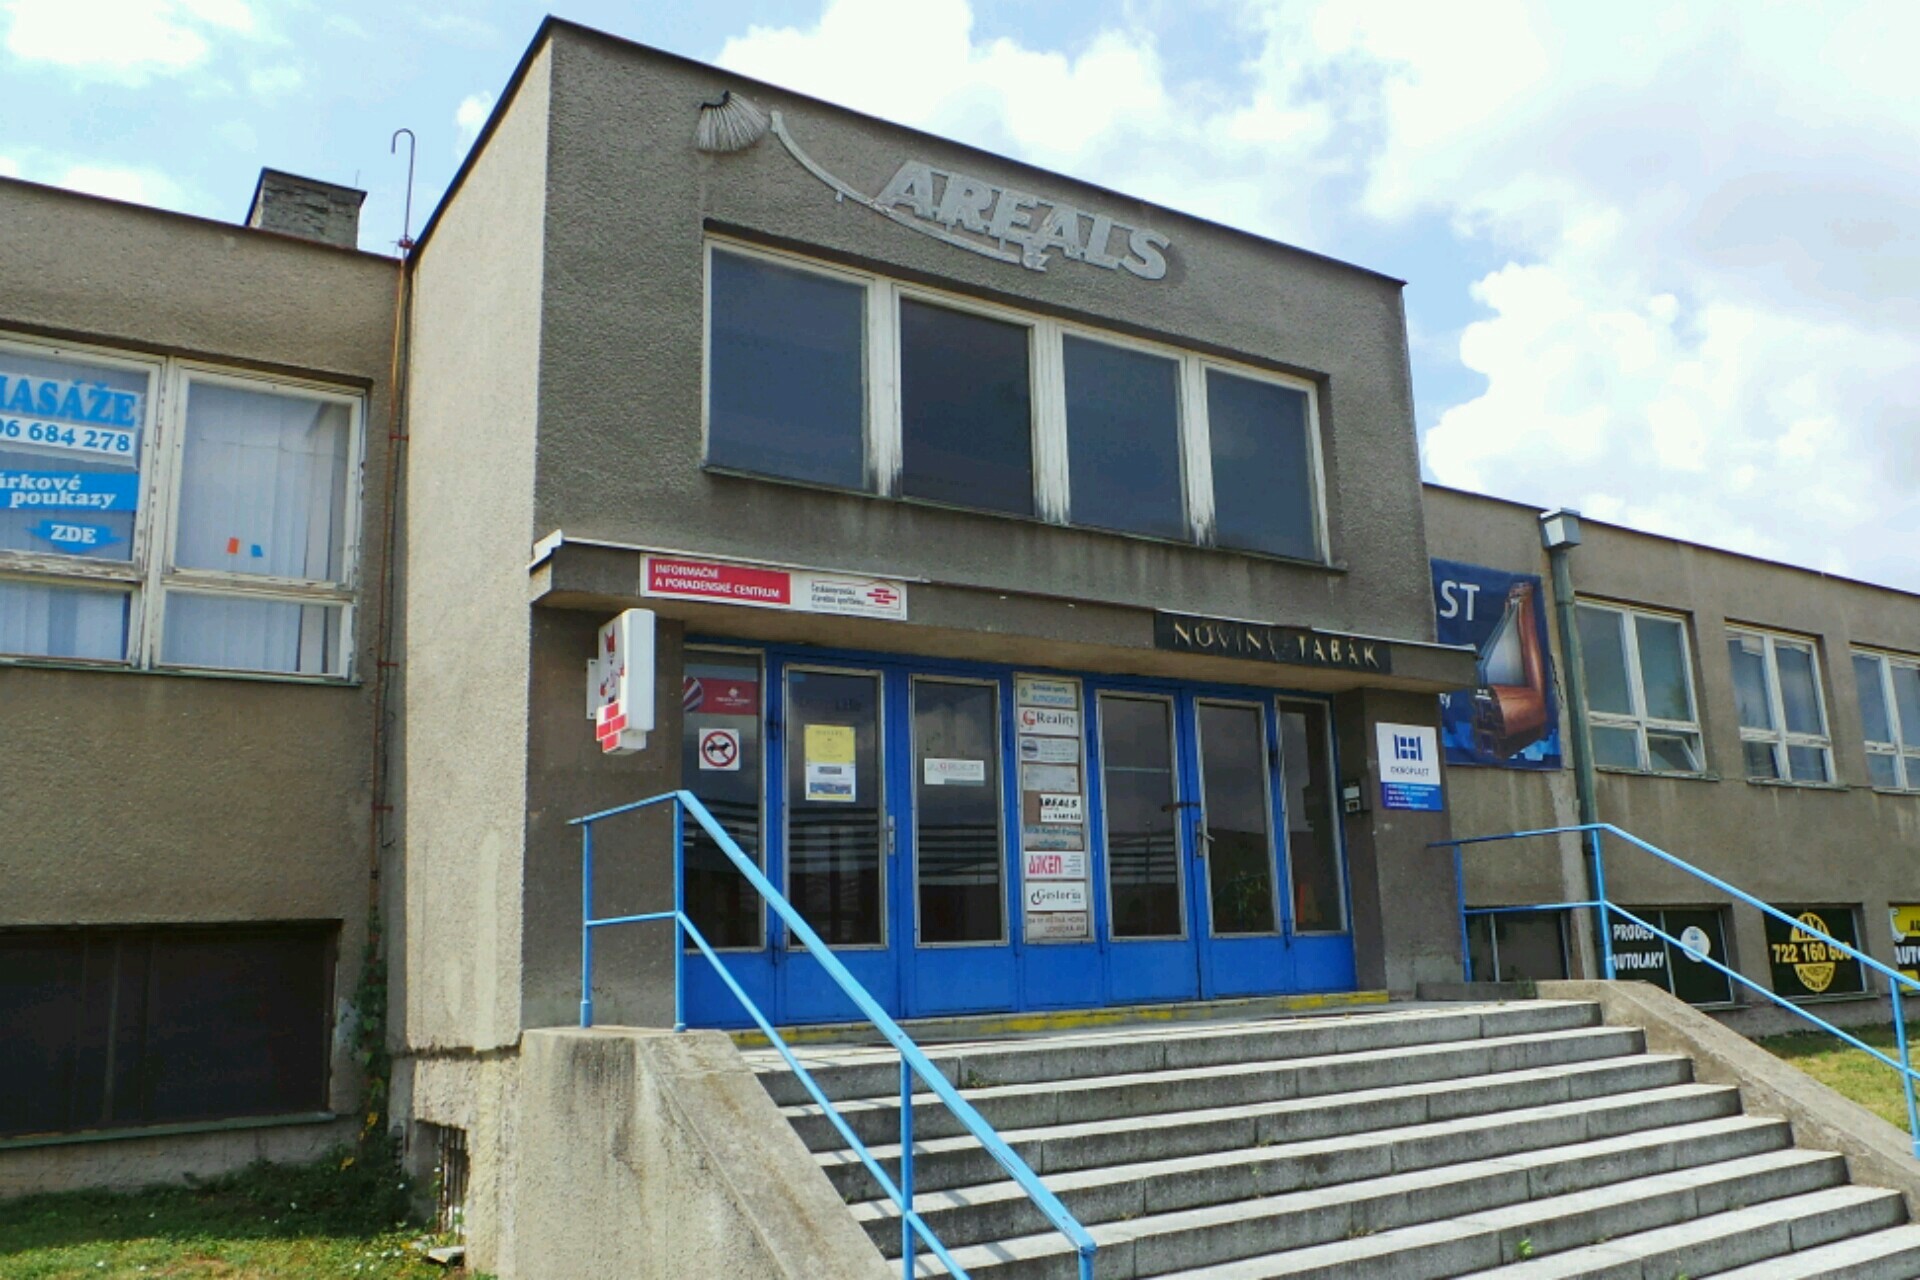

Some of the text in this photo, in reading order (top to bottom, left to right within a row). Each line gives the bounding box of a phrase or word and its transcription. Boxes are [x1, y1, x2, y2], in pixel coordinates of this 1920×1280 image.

[875, 160, 1171, 280] AREALS
[28, 423, 76, 446] 684
[83, 430, 131, 452] 278
[9, 491, 117, 509] poukazy
[50, 525, 97, 544] ZDE
[655, 564, 719, 579] INFORMAČNÍ
[655, 577, 780, 598] A PORADENSKÉ CENTRUM
[1772, 943, 1799, 963] 722
[1801, 943, 1826, 961] 160
